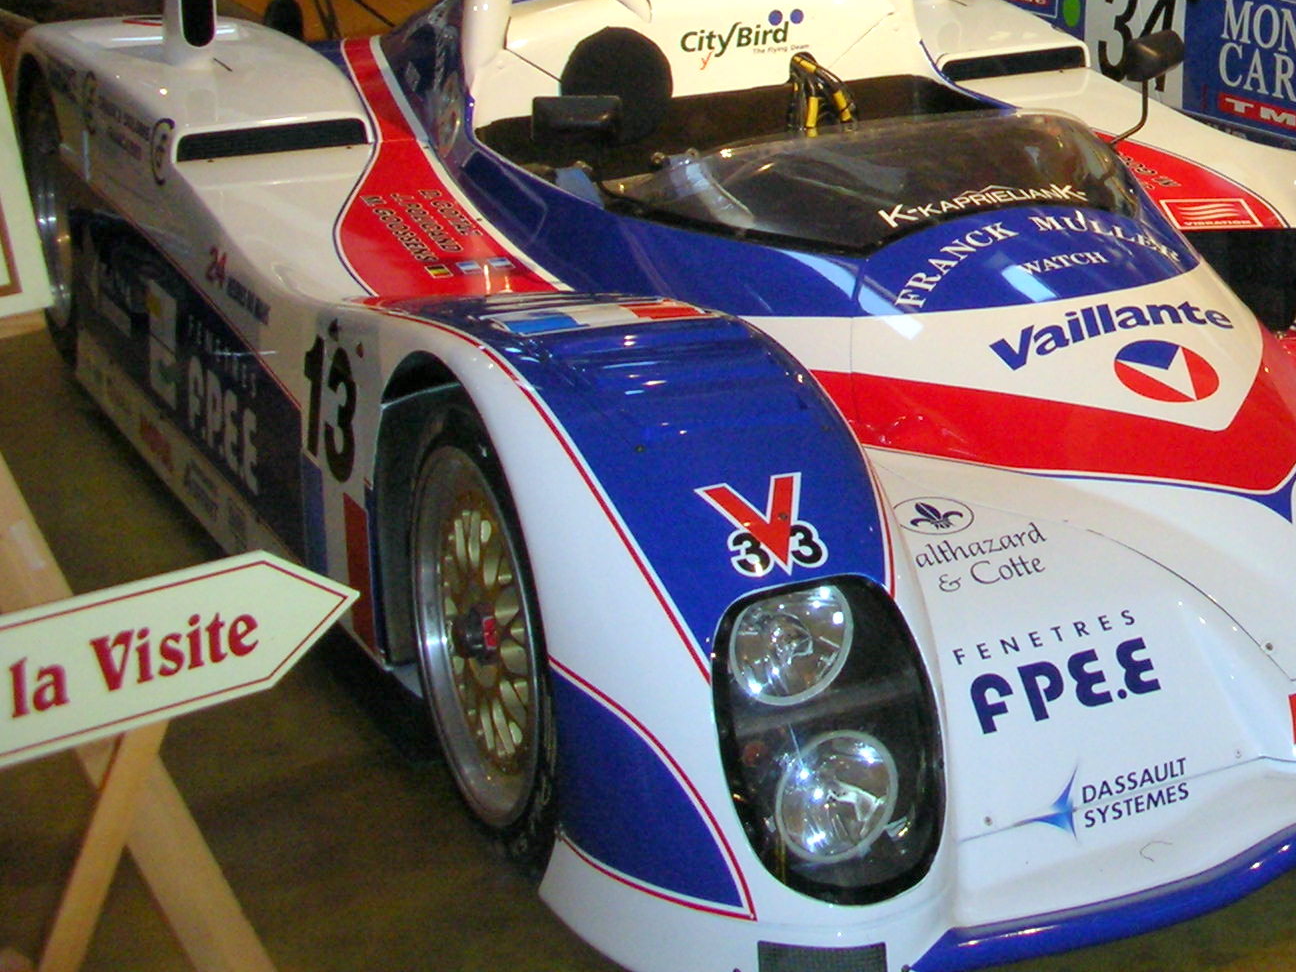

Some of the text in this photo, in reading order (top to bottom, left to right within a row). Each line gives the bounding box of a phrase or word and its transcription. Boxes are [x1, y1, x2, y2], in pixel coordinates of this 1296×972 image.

[895, 222, 1019, 308] FRANCK
[1017, 251, 1108, 275] WATCH
[989, 301, 1235, 371] Vaillante
[304, 334, 358, 483] 13
[915, 522, 1047, 568] althazard
[938, 555, 1046, 592] & Cotte
[953, 609, 1137, 665] FENETRES
[9, 612, 259, 719] la Visite
[1082, 757, 1188, 804] DASSAULT
[1084, 782, 1189, 828] SYSTEMES
